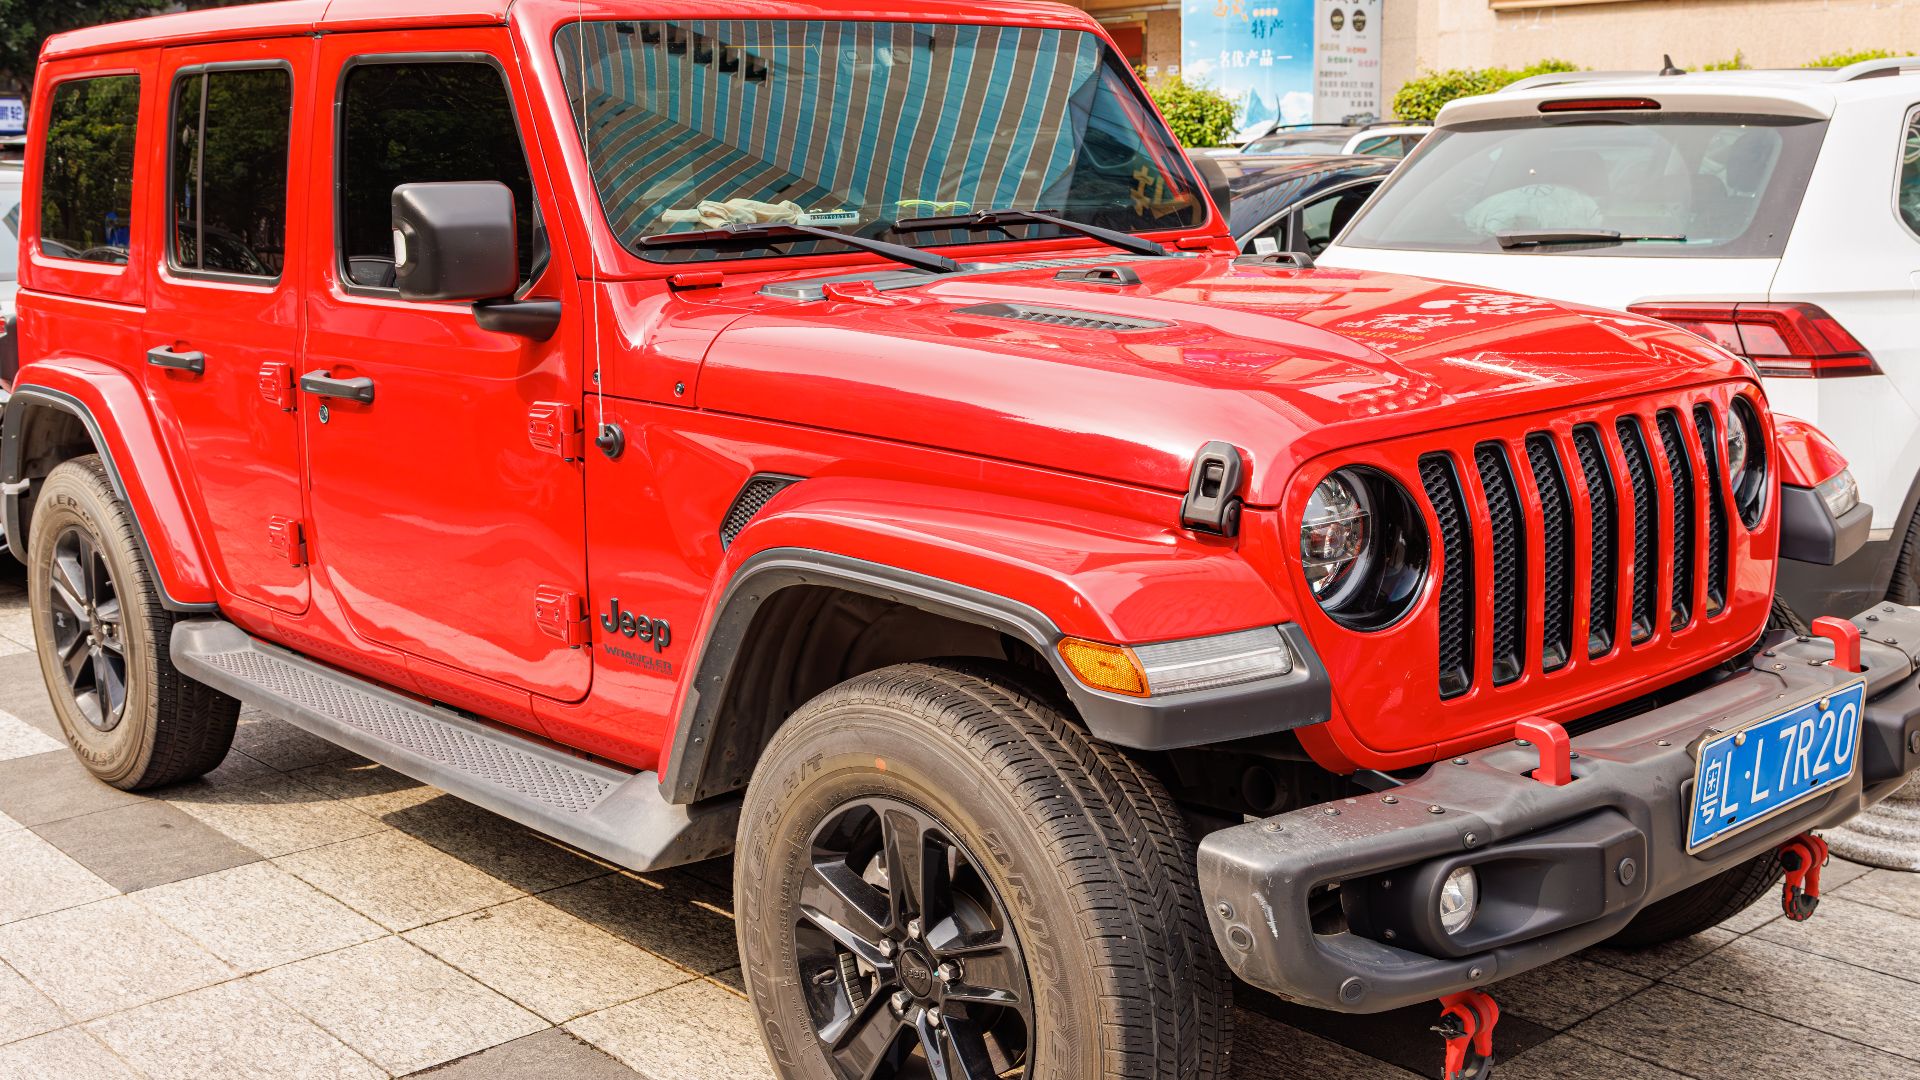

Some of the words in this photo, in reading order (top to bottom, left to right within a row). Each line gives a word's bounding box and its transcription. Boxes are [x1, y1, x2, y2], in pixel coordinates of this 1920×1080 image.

[1251, 18, 1284, 39] 特产
[1219, 49, 1273, 67] 名优产品
[600, 597, 671, 653] Jeep
[603, 642, 673, 671] WRANGLER
[979, 829, 1072, 1080] BRIDGE
